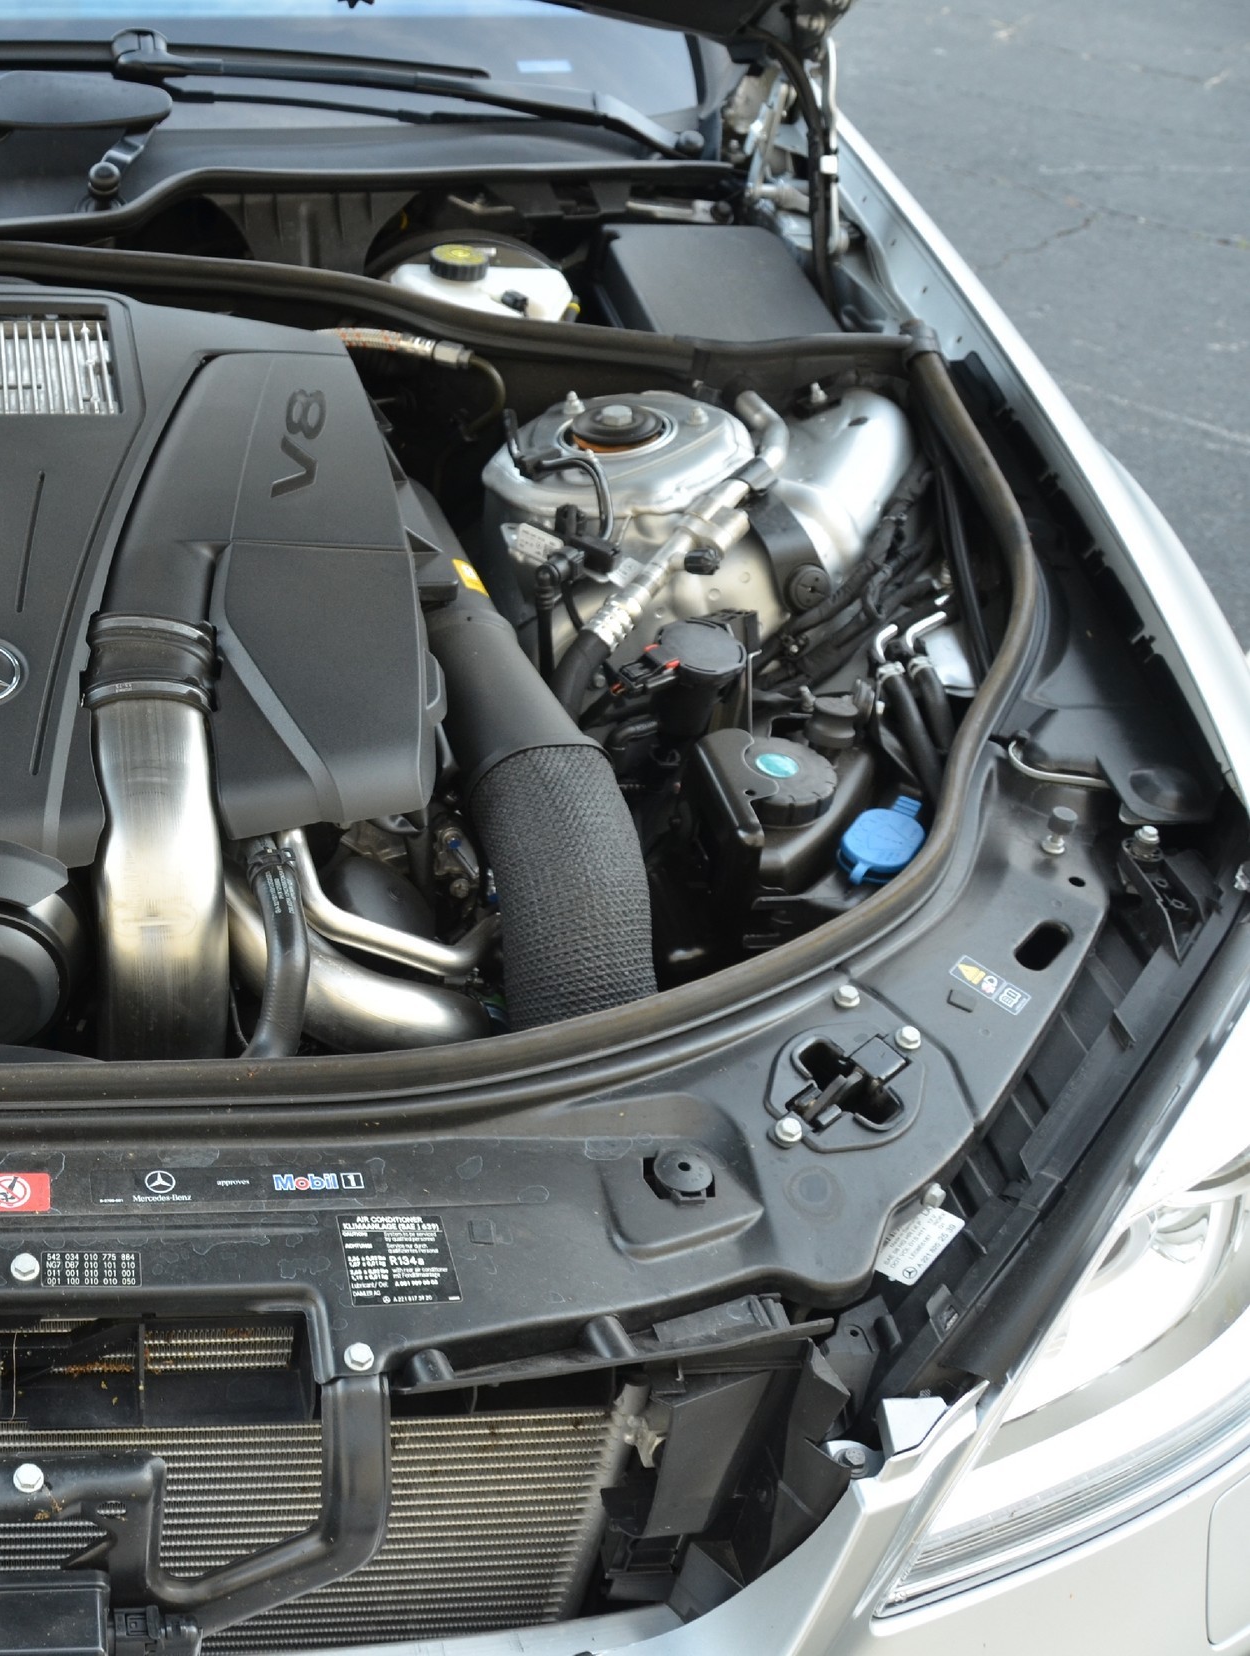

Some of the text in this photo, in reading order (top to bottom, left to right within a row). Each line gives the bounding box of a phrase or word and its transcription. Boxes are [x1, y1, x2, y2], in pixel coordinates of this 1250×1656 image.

[270, 388, 327, 498] V8
[272, 1174, 339, 1190] Mobil
[132, 1194, 192, 1202] Mercedes-Benz
